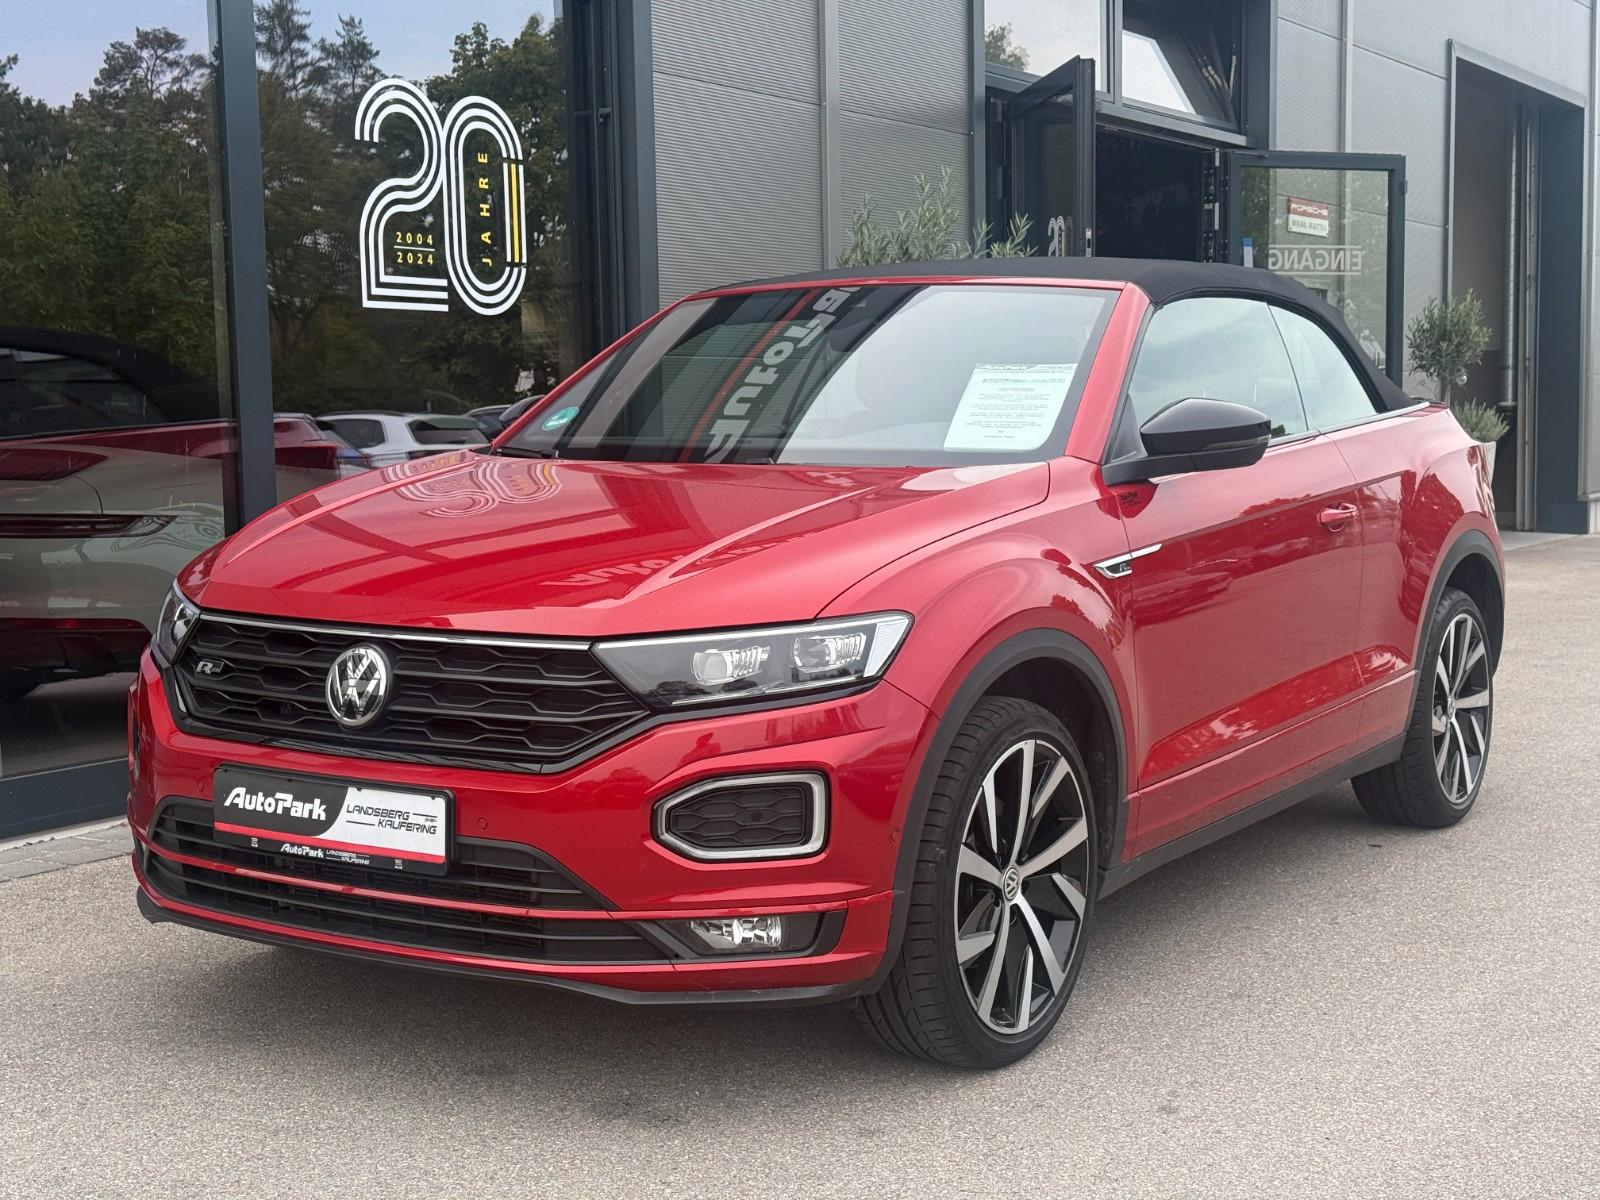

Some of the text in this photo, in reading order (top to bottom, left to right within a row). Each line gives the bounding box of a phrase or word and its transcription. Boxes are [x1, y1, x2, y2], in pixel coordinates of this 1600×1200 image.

[355, 78, 527, 315] 20
[478, 152, 492, 267] JAHRE
[396, 231, 433, 246] 2004
[397, 251, 434, 266] 2024
[223, 787, 327, 821] AutoPark
[346, 804, 411, 820] LANDSBERG
[377, 818, 438, 834] KAUFERING
[280, 843, 324, 859] AutoPark
